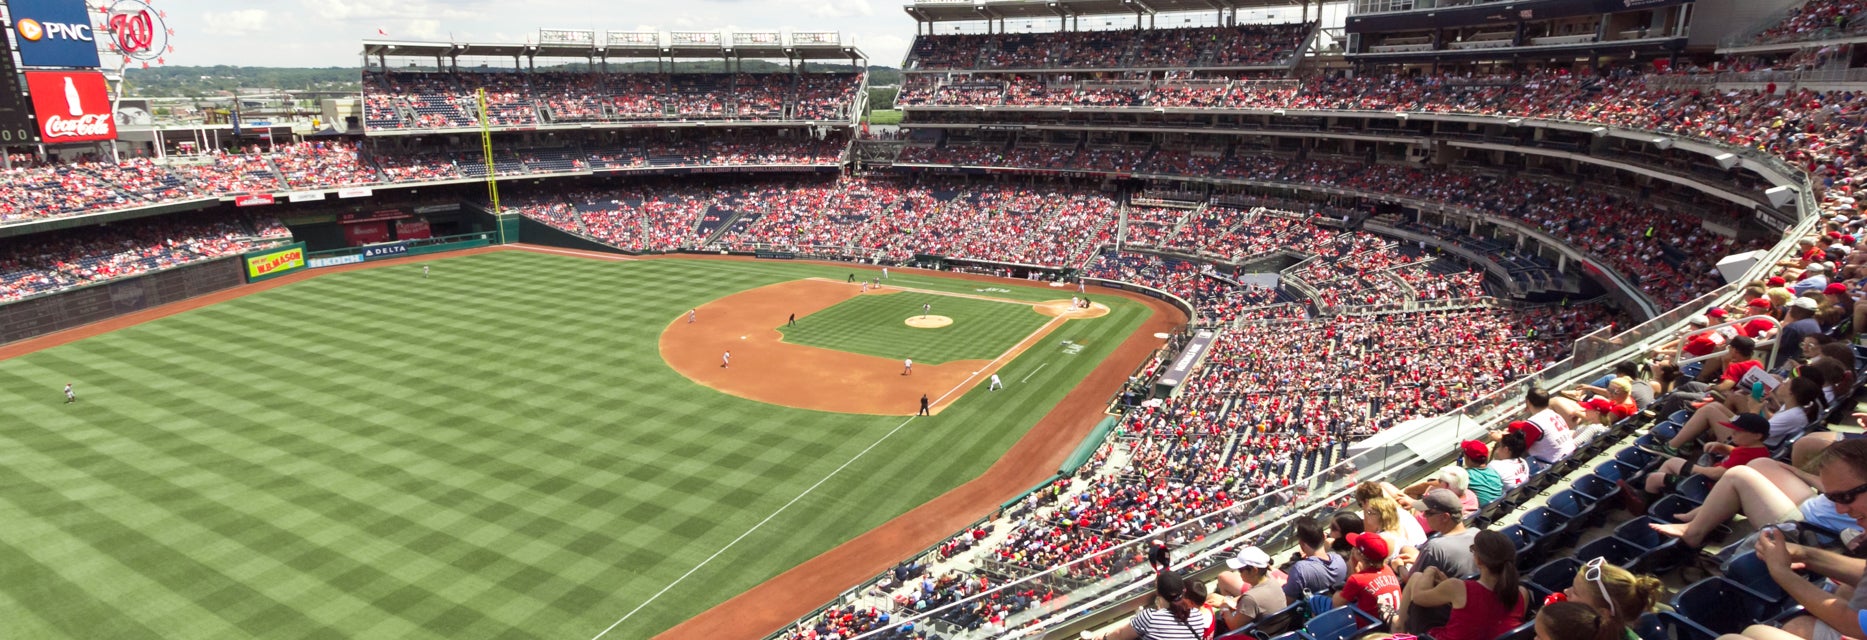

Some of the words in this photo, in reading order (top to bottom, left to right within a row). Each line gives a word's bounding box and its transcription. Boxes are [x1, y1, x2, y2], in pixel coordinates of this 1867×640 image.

[42, 22, 93, 41] PNC
[45, 114, 110, 138] Coca-Cola
[375, 245, 406, 255] DELTA
[1365, 575, 1399, 595] SCHERZE
